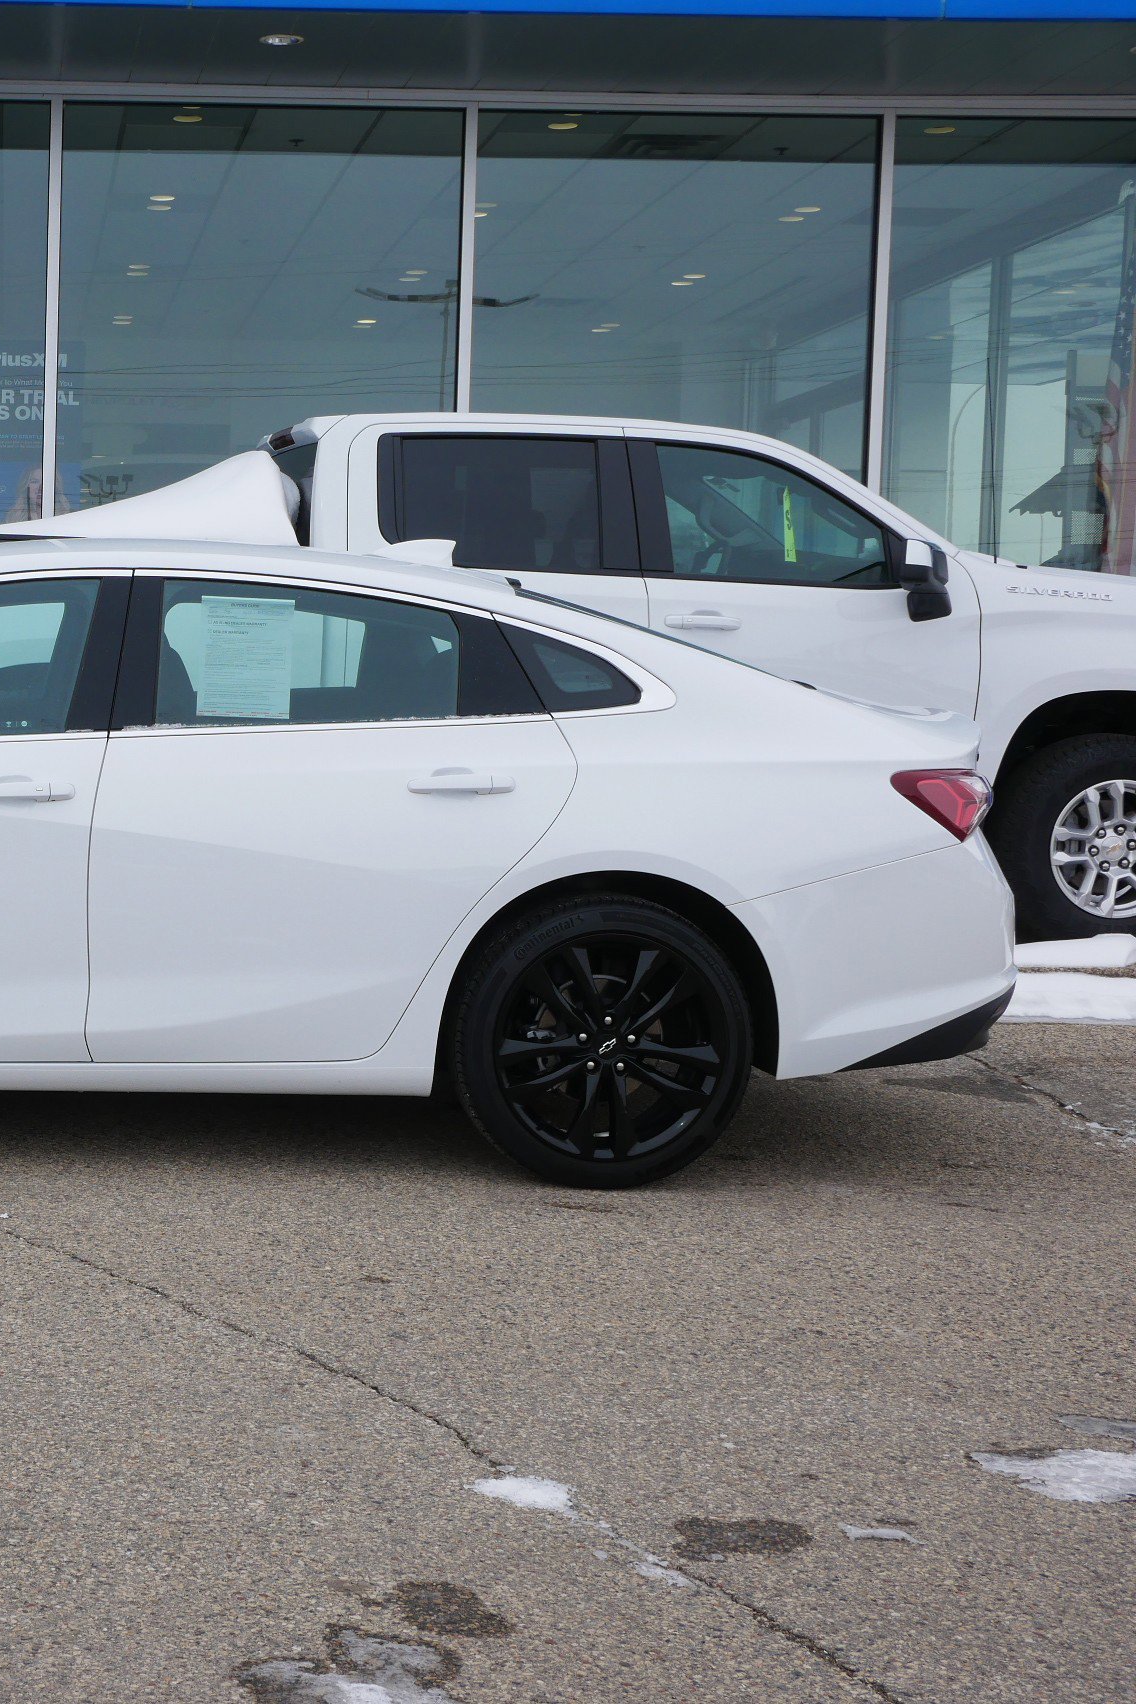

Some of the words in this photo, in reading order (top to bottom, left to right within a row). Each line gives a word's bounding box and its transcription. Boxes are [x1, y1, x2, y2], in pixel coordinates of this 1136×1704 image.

[20, 390, 80, 406] TRAL
[1005, 585, 1113, 601] SILVERADO
[513, 917, 576, 960] Continental
